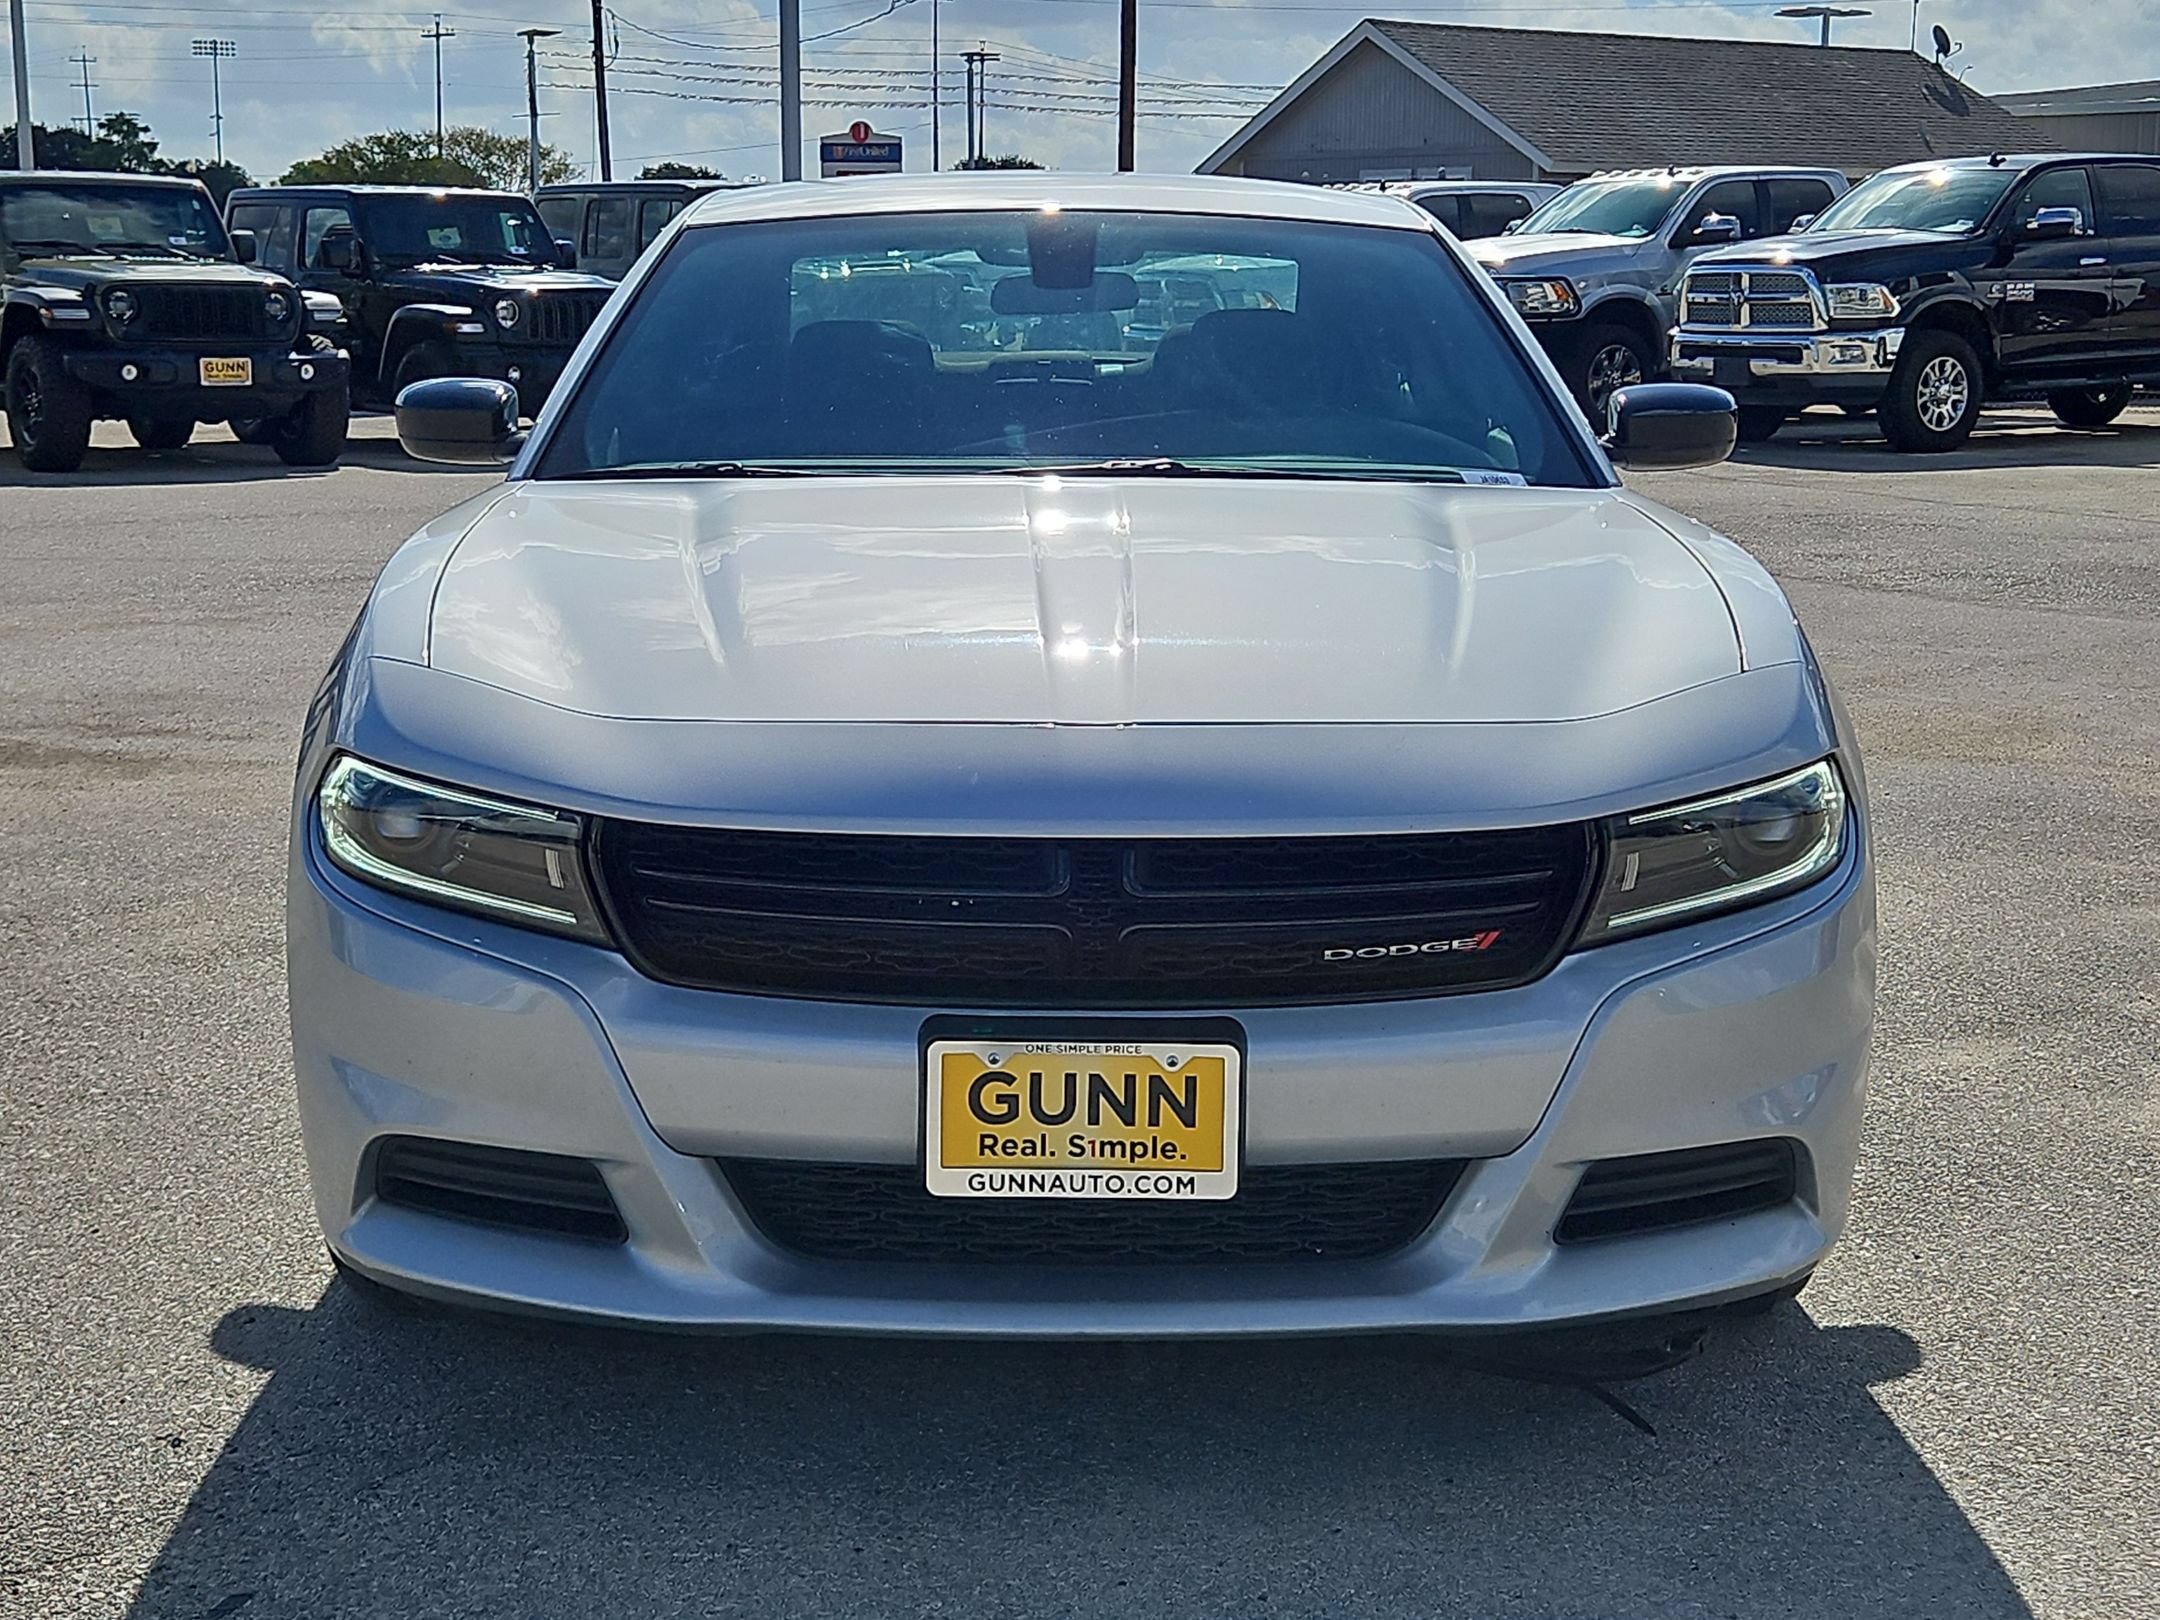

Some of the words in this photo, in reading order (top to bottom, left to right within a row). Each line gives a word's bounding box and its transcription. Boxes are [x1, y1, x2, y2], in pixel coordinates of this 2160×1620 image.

[204, 361, 246, 373] GUNN
[1323, 938, 1479, 961] DODGE
[1025, 1044, 1053, 1053] ONE
[1056, 1044, 1101, 1054] SIMPLE
[1105, 1045, 1142, 1054] PRICE
[968, 1071, 1197, 1128] GUNN
[978, 1133, 1056, 1157] Real.
[968, 1173, 1196, 1194] GUNNAUTO.COM
